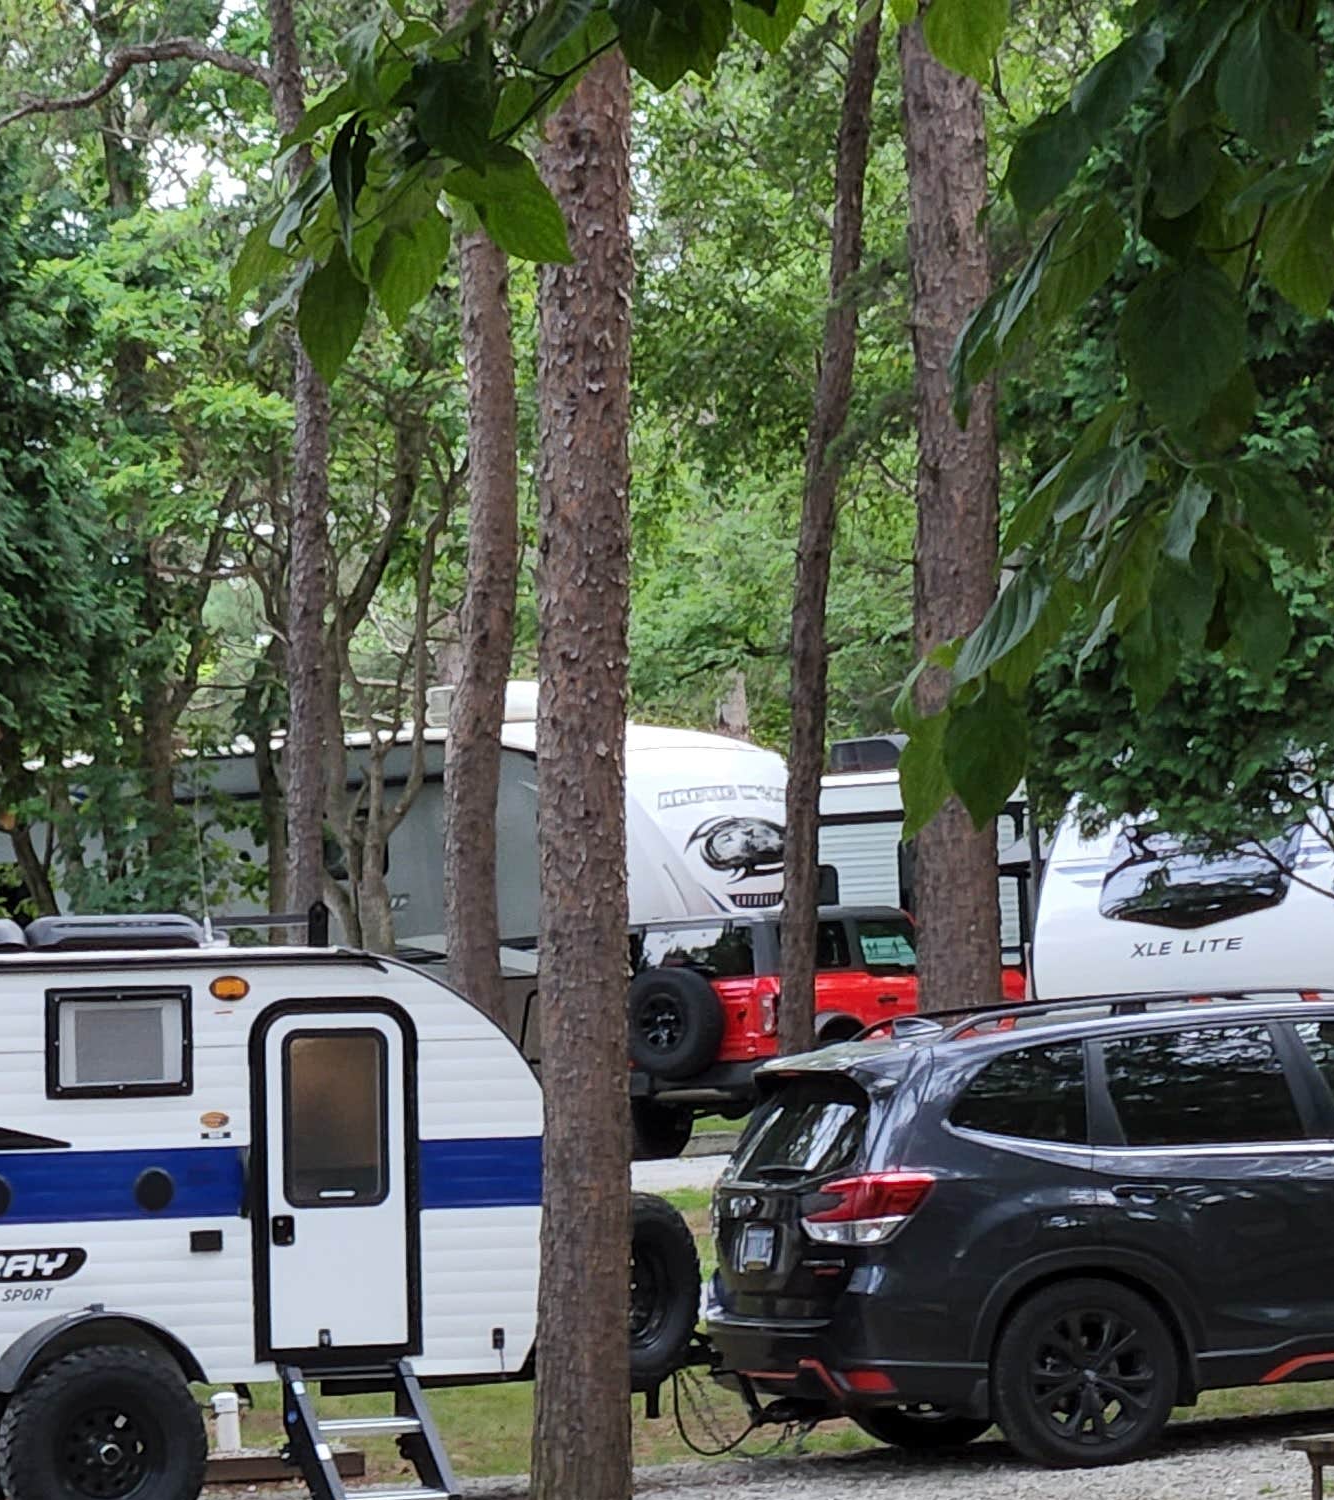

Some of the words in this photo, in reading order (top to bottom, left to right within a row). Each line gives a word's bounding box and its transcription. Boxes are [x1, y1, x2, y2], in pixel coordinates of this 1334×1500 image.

[1130, 940, 1173, 958] XLE
[1181, 936, 1243, 954] LITE
[1, 1287, 54, 1302] SPORT
